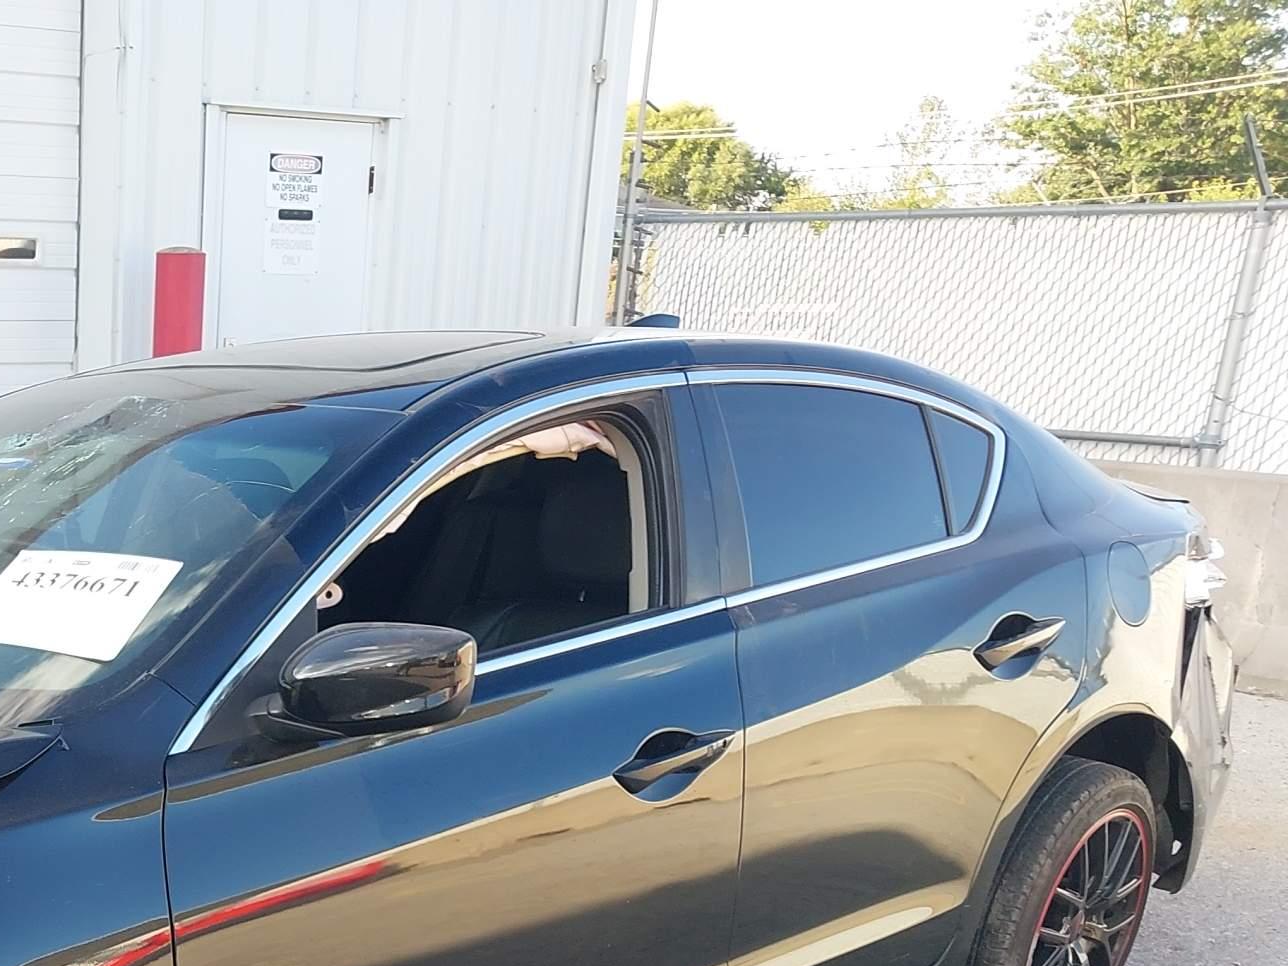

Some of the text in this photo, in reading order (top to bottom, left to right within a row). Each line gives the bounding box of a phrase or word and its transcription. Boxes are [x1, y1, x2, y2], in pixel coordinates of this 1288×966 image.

[277, 158, 316, 170] DANGER
[288, 175, 312, 183] SMOKING
[272, 183, 318, 193] NO OPEN FLAMES
[280, 193, 310, 202] NO SPARKS
[12, 571, 140, 597] 43376671
